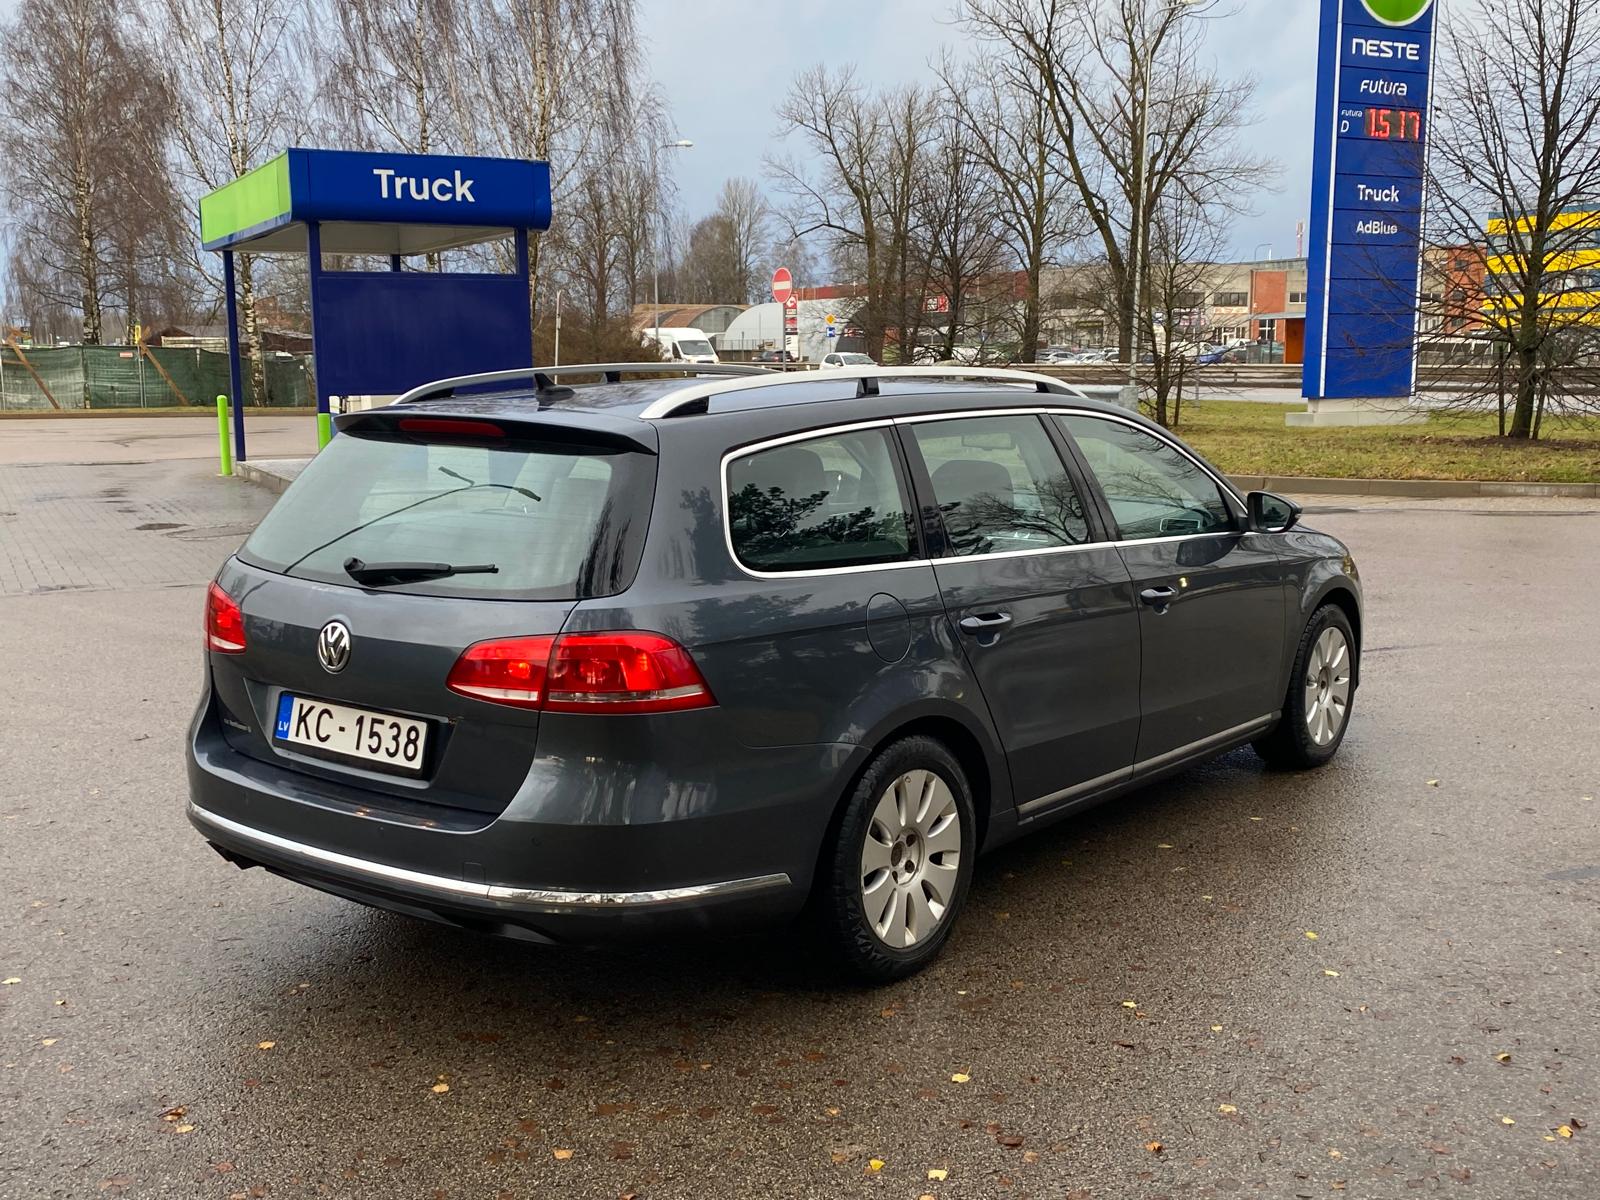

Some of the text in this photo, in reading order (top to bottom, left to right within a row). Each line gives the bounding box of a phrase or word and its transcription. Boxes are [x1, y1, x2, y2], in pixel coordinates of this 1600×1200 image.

[1351, 38, 1420, 60] NESTE
[1360, 79, 1408, 96] Futura
[1340, 120, 1350, 133] D
[373, 168, 475, 202] Truck
[1357, 184, 1399, 202] Truck
[1356, 220, 1398, 235] AdBlue
[278, 721, 289, 731] LV
